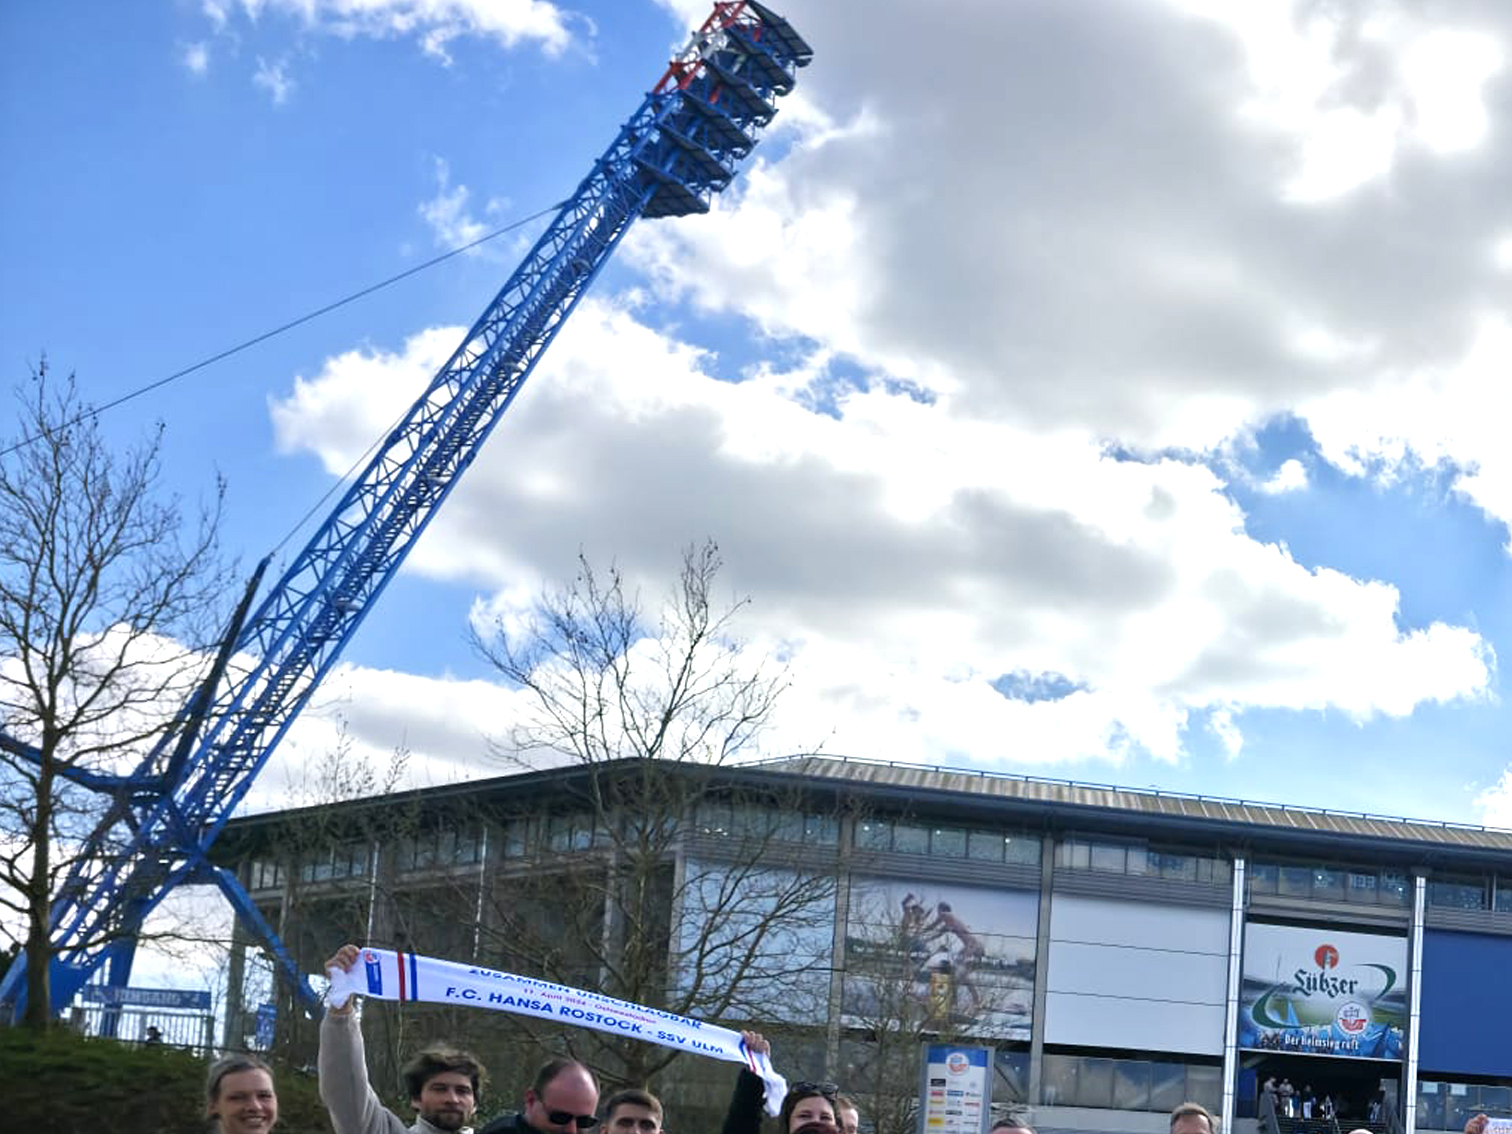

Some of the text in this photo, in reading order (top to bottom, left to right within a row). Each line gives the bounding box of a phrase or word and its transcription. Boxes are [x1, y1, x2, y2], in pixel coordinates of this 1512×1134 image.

[1293, 968, 1358, 998] Lübzer
[446, 987, 482, 1001] F.C.
[489, 992, 553, 1014] HANSA
[559, 1006, 642, 1034] ROSTOCK
[657, 1030, 687, 1045] SSV
[692, 1041, 724, 1054] ULM
